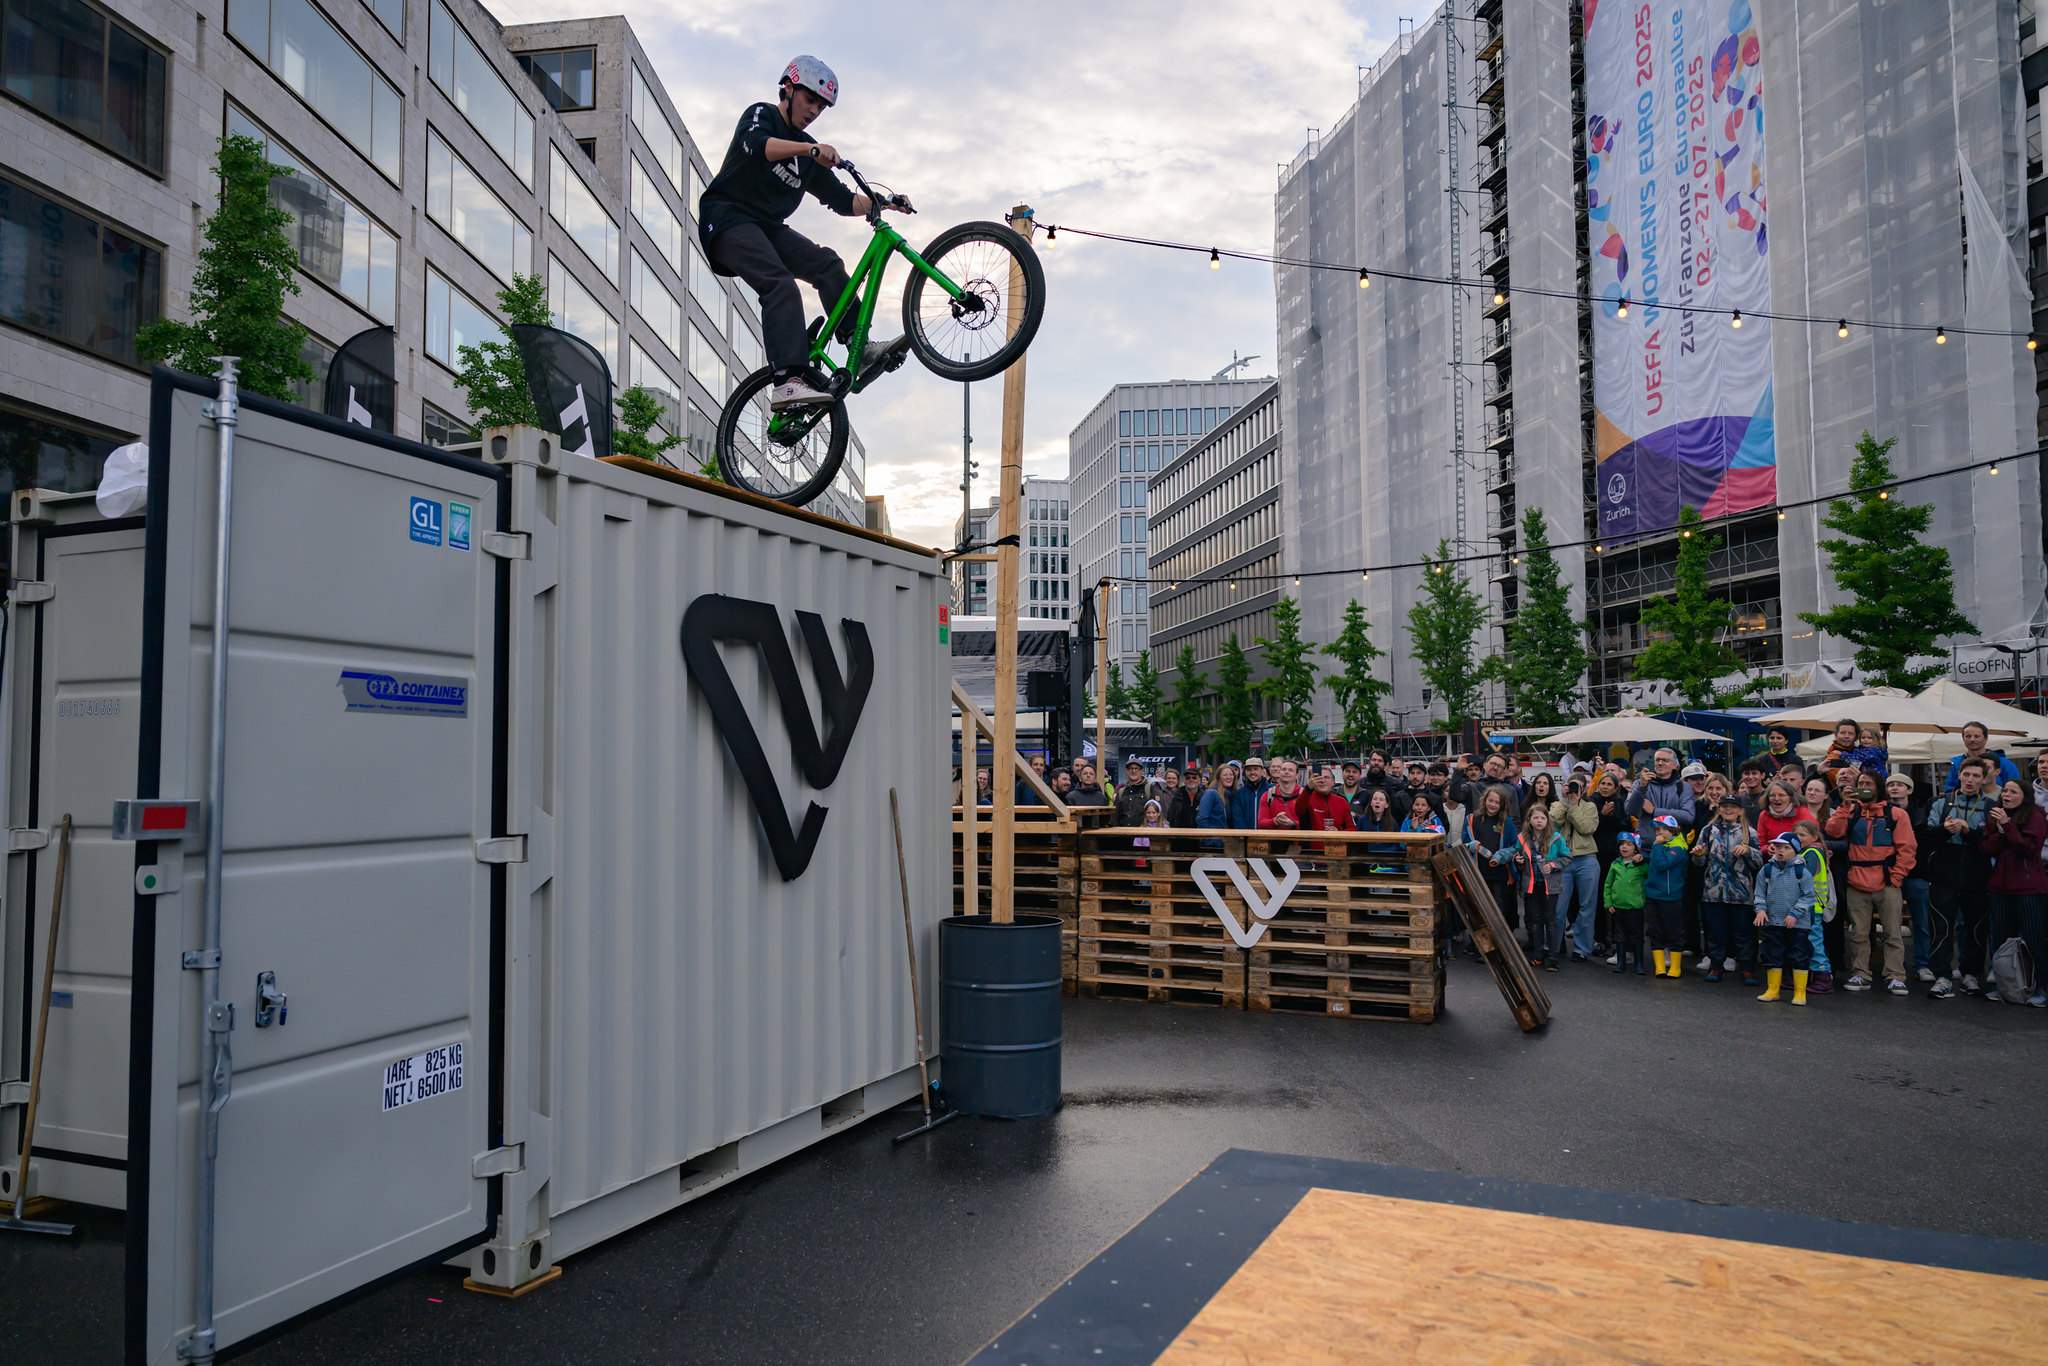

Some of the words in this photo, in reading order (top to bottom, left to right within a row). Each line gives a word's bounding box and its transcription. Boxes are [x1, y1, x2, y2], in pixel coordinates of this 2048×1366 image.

[1635, 3, 1653, 88] 2025
[1637, 90, 1655, 175] EURO
[1672, 8, 1689, 176] Europaallee
[1640, 179, 1660, 328] WOMEN'S
[1645, 329, 1663, 416] UEFA
[412, 502, 440, 531] GL
[369, 680, 397, 696] CTX
[401, 682, 465, 699] CONTAINEX
[418, 1071, 446, 1100] 6500
[448, 1066, 462, 1091] KG
[425, 1048, 446, 1073] 825
[449, 1043, 462, 1067] KG
